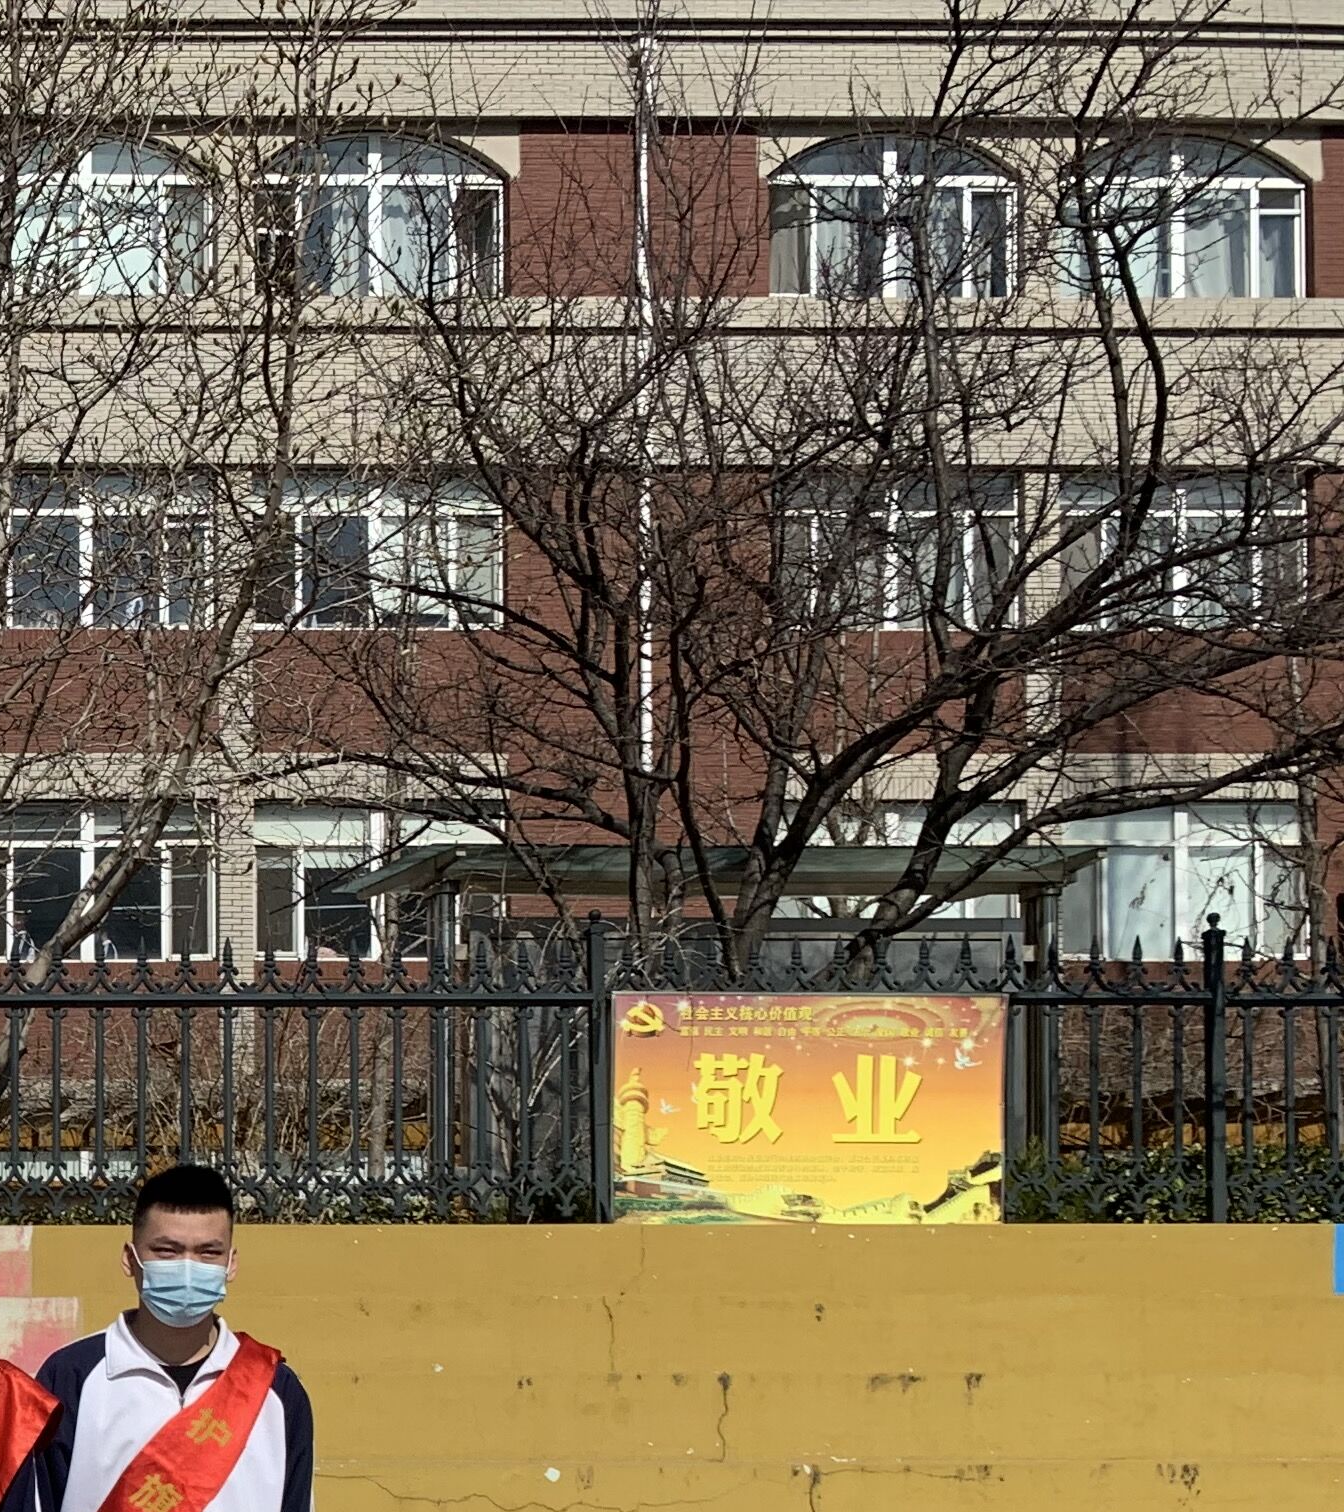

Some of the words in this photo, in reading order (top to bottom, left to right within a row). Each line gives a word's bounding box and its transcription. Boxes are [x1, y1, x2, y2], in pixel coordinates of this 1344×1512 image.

[680, 1005, 814, 1021] 社会主义核心价值观
[693, 1052, 922, 1144] 敬业
